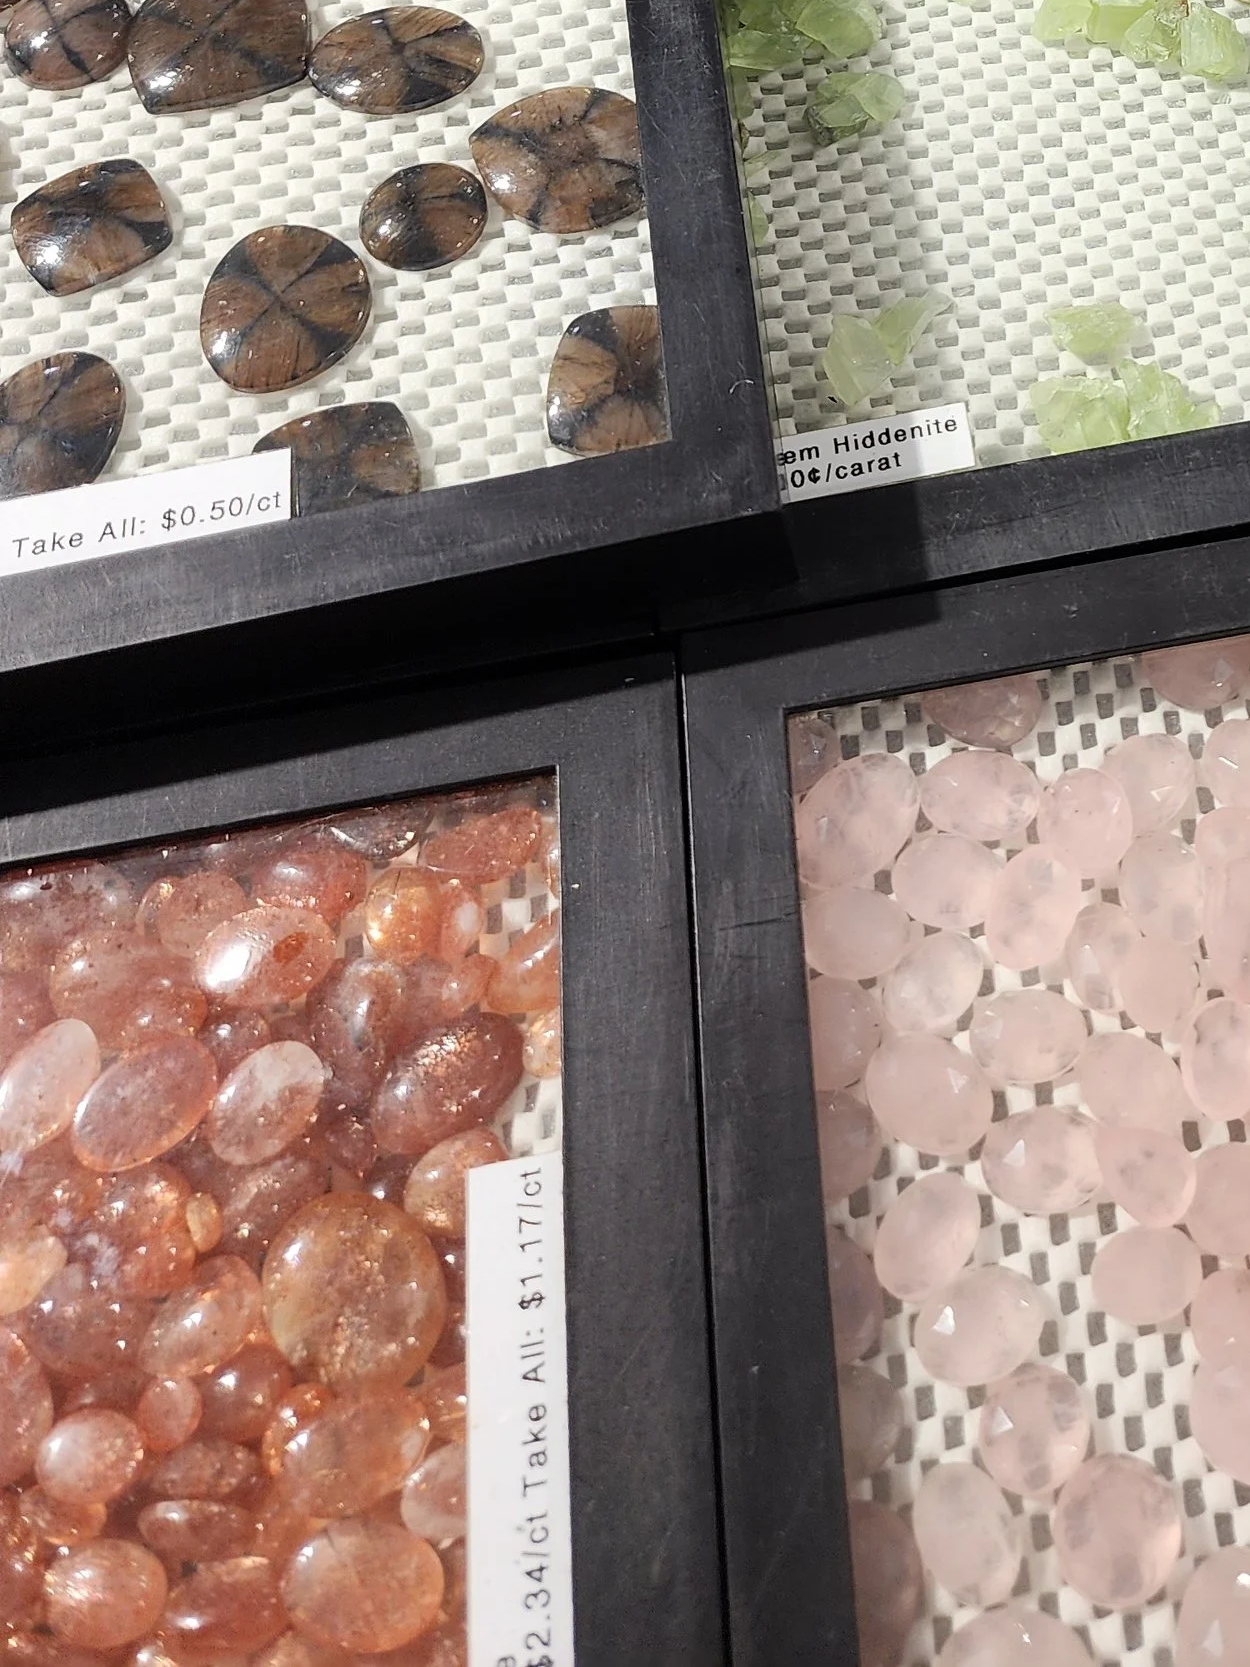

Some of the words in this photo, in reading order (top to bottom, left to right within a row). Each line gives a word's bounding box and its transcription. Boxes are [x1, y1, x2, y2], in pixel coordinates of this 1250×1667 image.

[832, 417, 958, 455] Hiddenite
[12, 530, 85, 559] Take
[97, 516, 147, 543] All:
[160, 490, 282, 532] $0.50/ct
[516, 1166, 547, 1311] $1.17/ct
[520, 1326, 547, 1385] All:
[521, 1402, 549, 1500] Take
